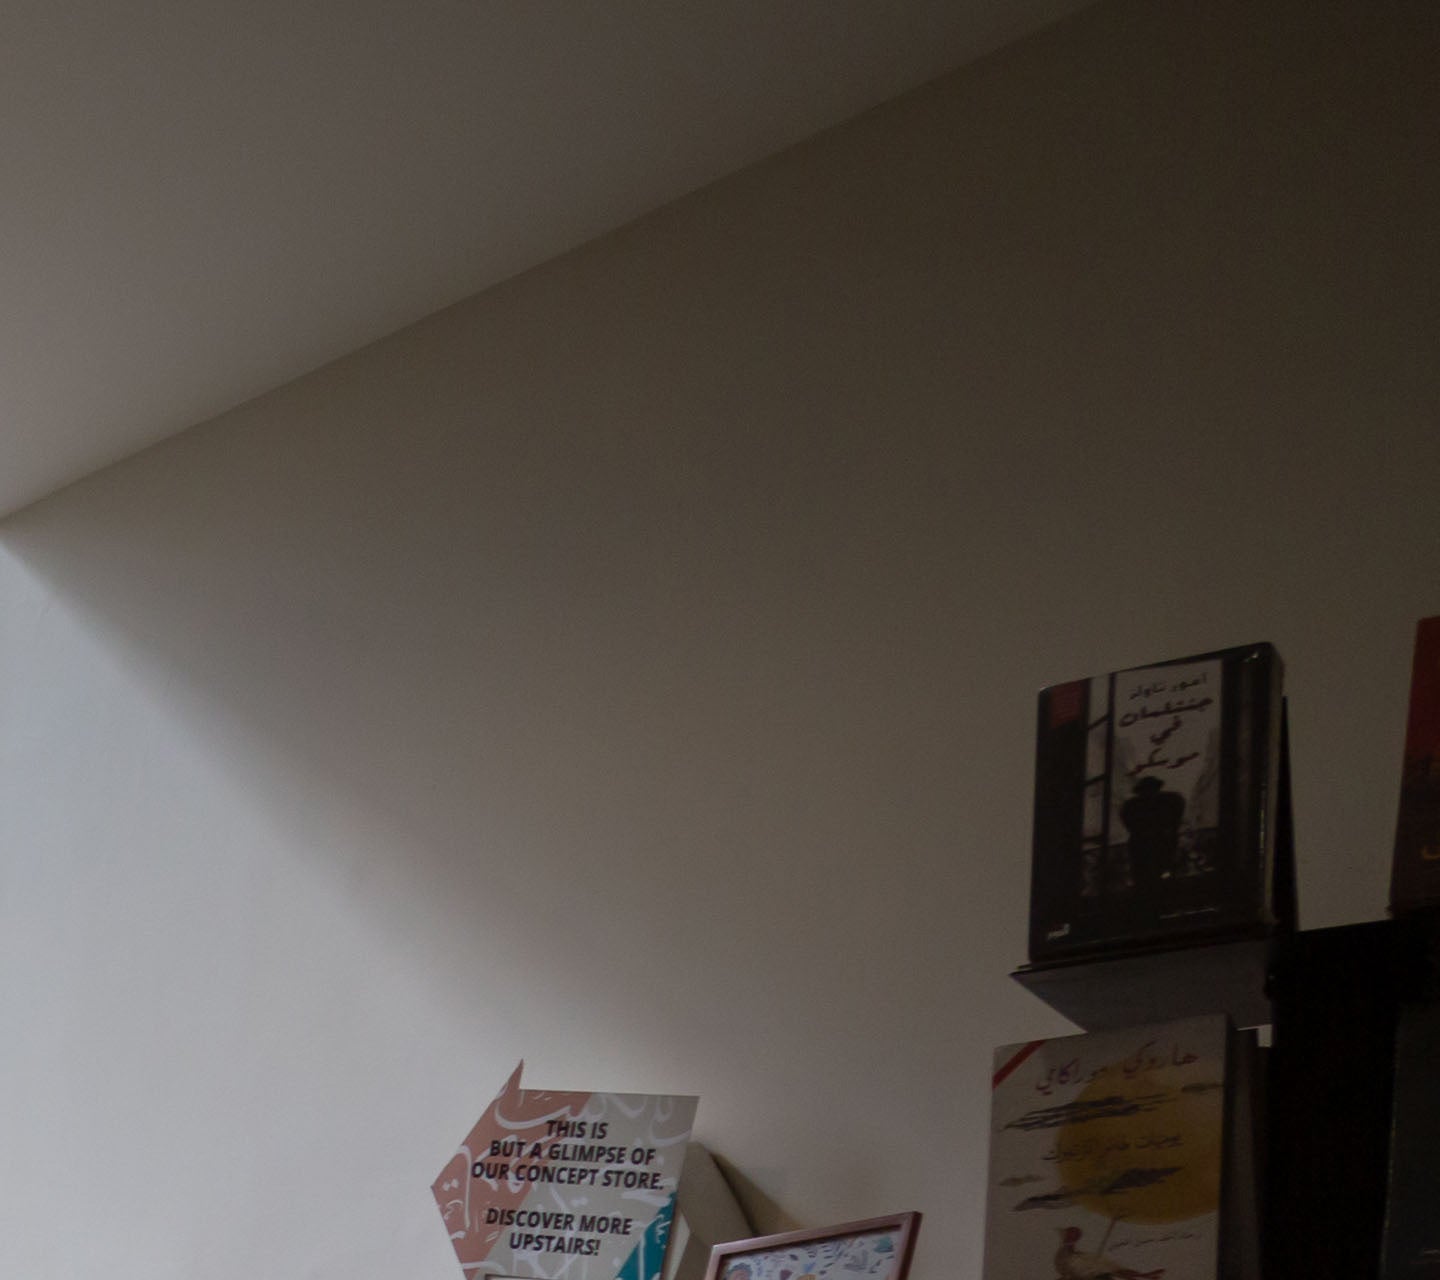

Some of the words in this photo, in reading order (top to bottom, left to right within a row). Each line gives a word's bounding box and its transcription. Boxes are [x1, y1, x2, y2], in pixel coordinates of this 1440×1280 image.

[546, 1118, 586, 1138] THIS
[591, 1120, 608, 1139] IS
[490, 1138, 525, 1160] BUT
[530, 1141, 542, 1160] A
[549, 1142, 625, 1165] GLIMPSE
[632, 1147, 656, 1165] OF
[472, 1160, 508, 1180] OUR
[515, 1163, 596, 1187] CONCEPT
[602, 1168, 664, 1190] STORE.
[486, 1208, 573, 1231] DISCOVER
[580, 1212, 632, 1235] MORE
[509, 1232, 601, 1257] UPSTAIRS!
